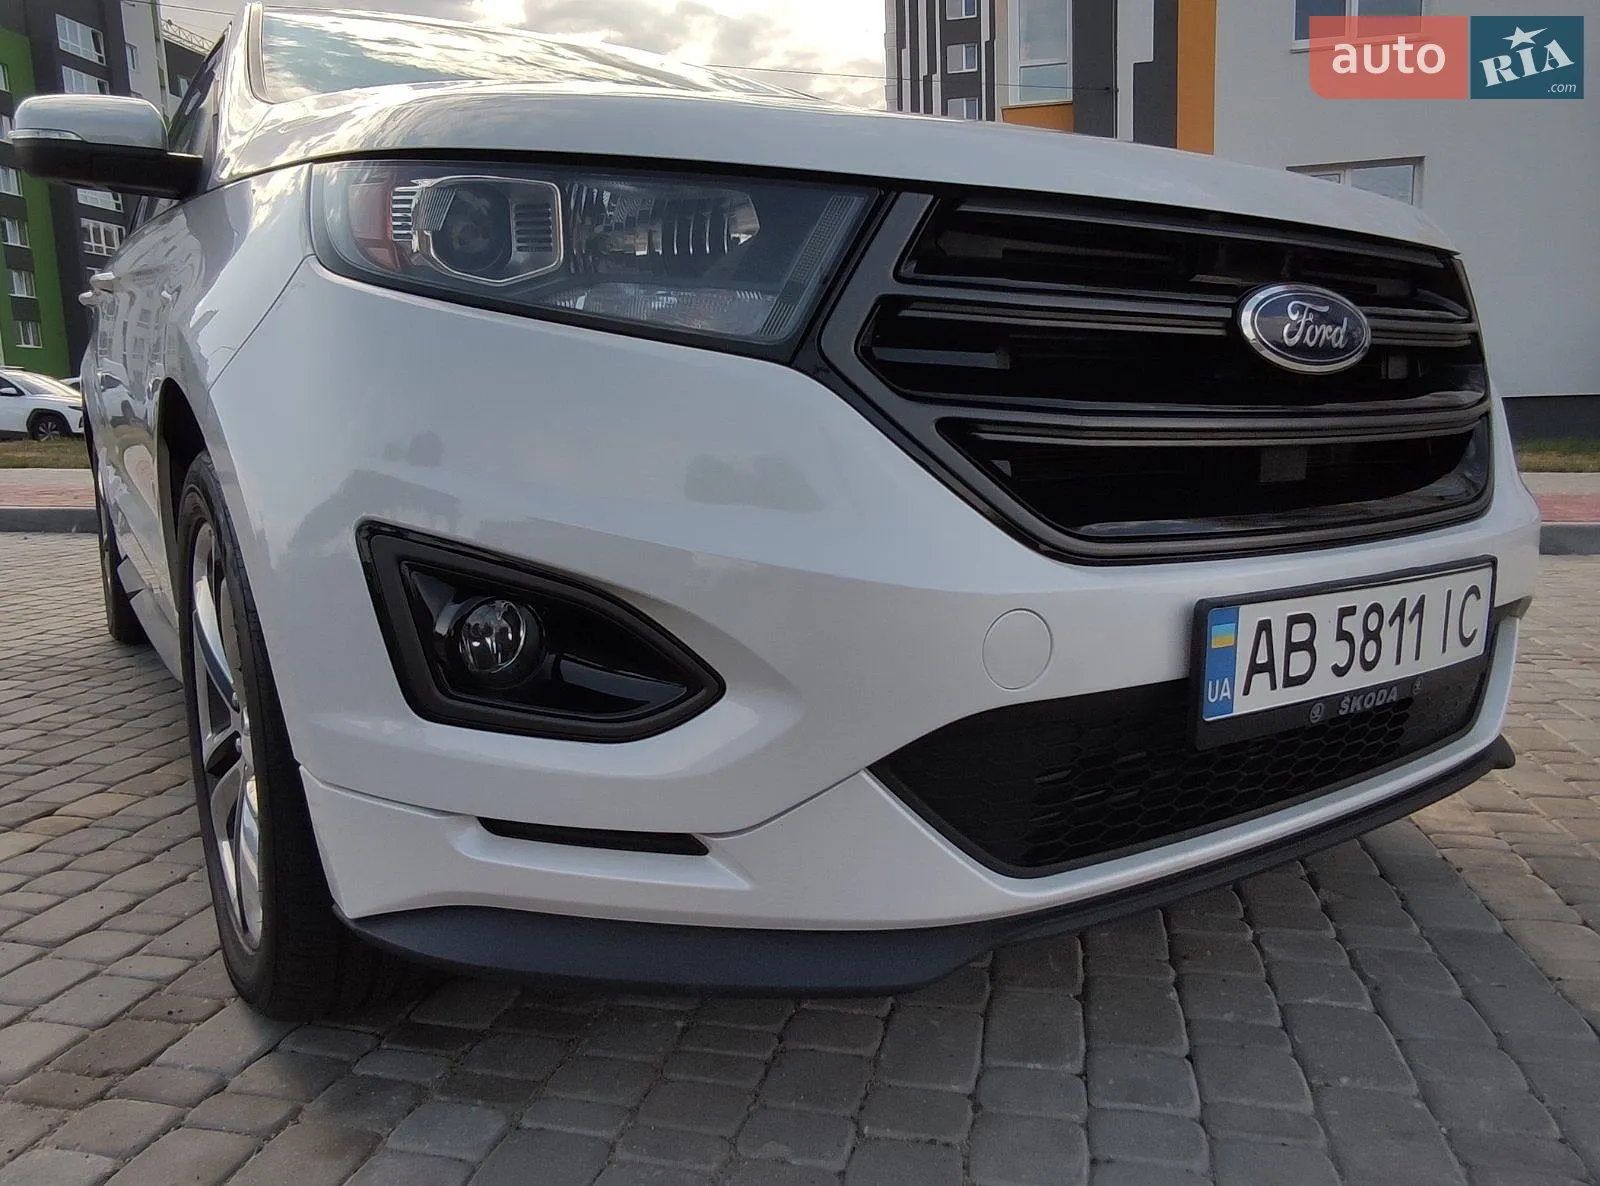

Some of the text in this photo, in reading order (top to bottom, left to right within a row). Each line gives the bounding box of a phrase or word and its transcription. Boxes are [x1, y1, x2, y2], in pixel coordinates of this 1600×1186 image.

[1283, 300, 1348, 348] Ford
[1242, 585, 1481, 696] AB 5811 IC
[1207, 677, 1231, 703] UA
